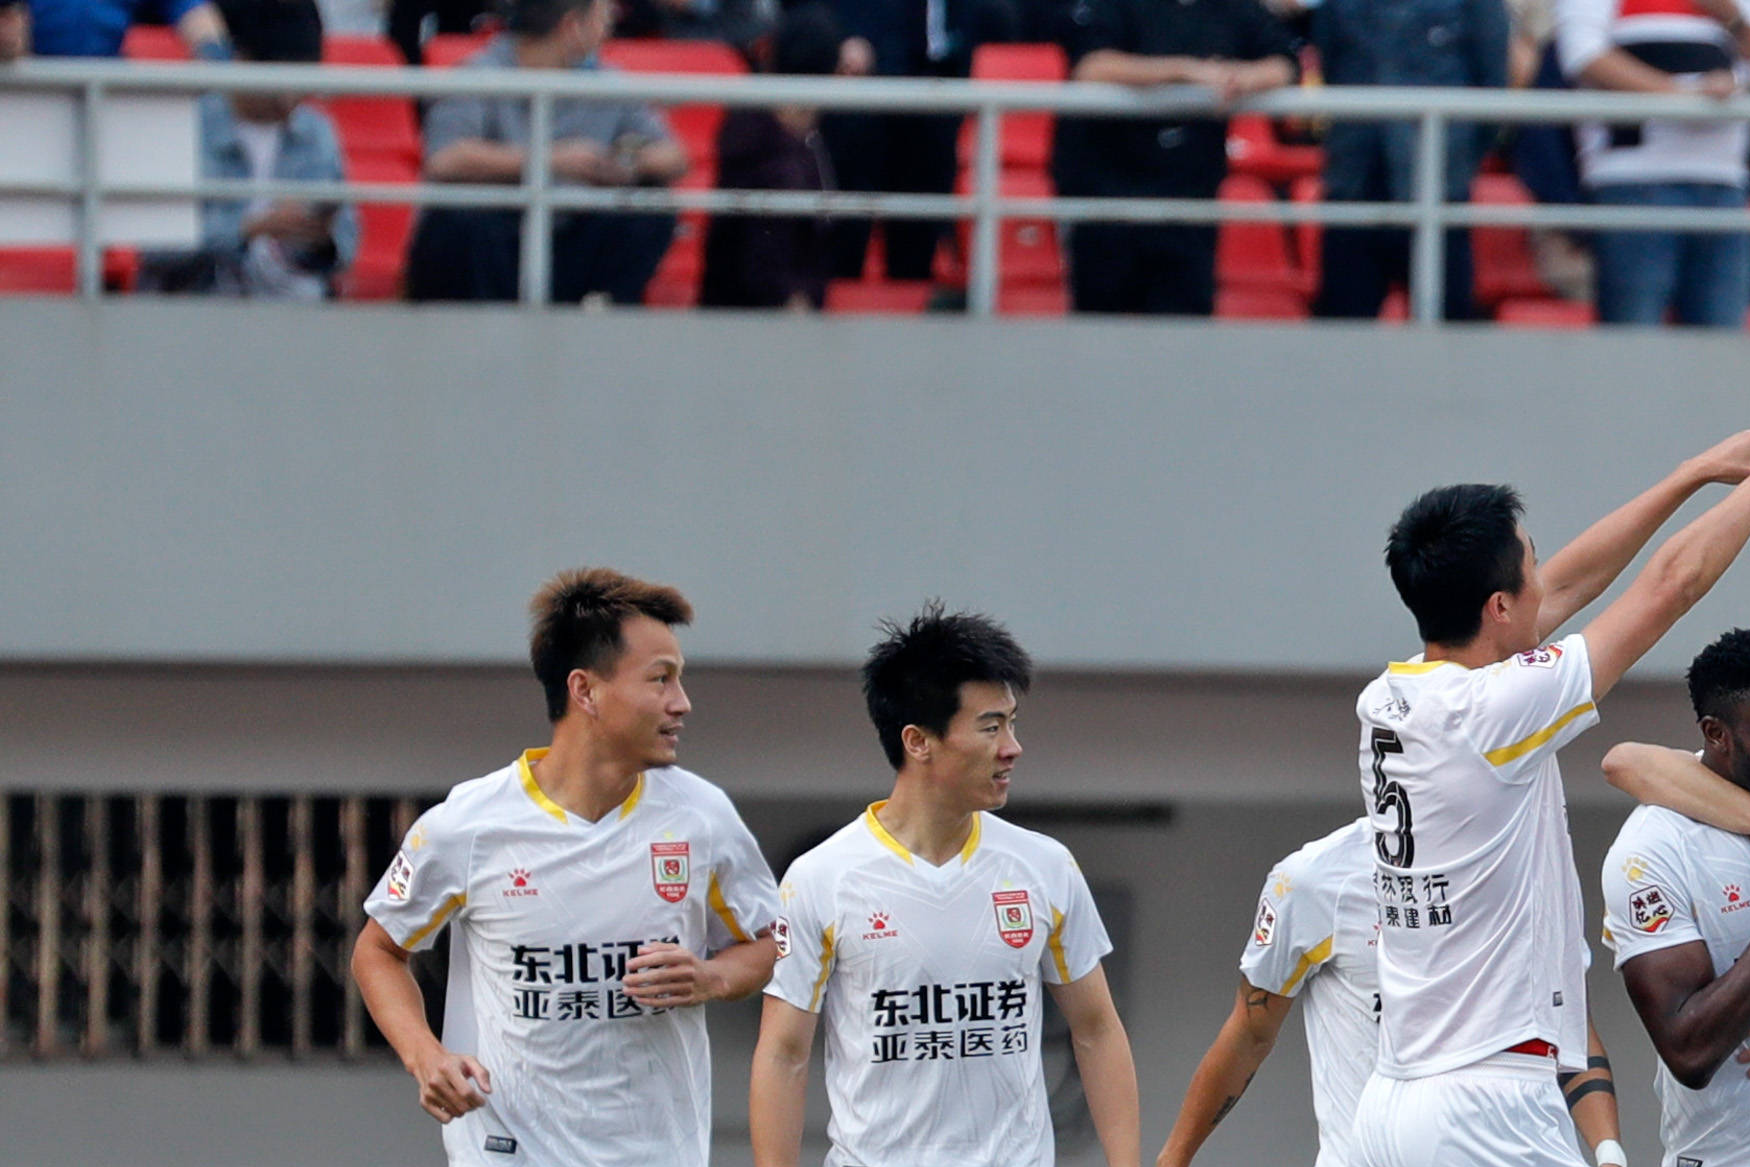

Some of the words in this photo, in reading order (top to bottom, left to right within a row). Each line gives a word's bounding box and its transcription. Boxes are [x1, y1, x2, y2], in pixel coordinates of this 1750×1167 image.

[1371, 727, 1415, 868] 5
[502, 888, 539, 897] KELME
[863, 929, 898, 940] KELME
[1378, 905, 1452, 929] 泰建材
[511, 934, 680, 984] 东北证
[512, 986, 676, 1021] 亚泰医
[871, 979, 1027, 1027] 东北证券
[871, 1023, 1027, 1063] 亚泰医药
